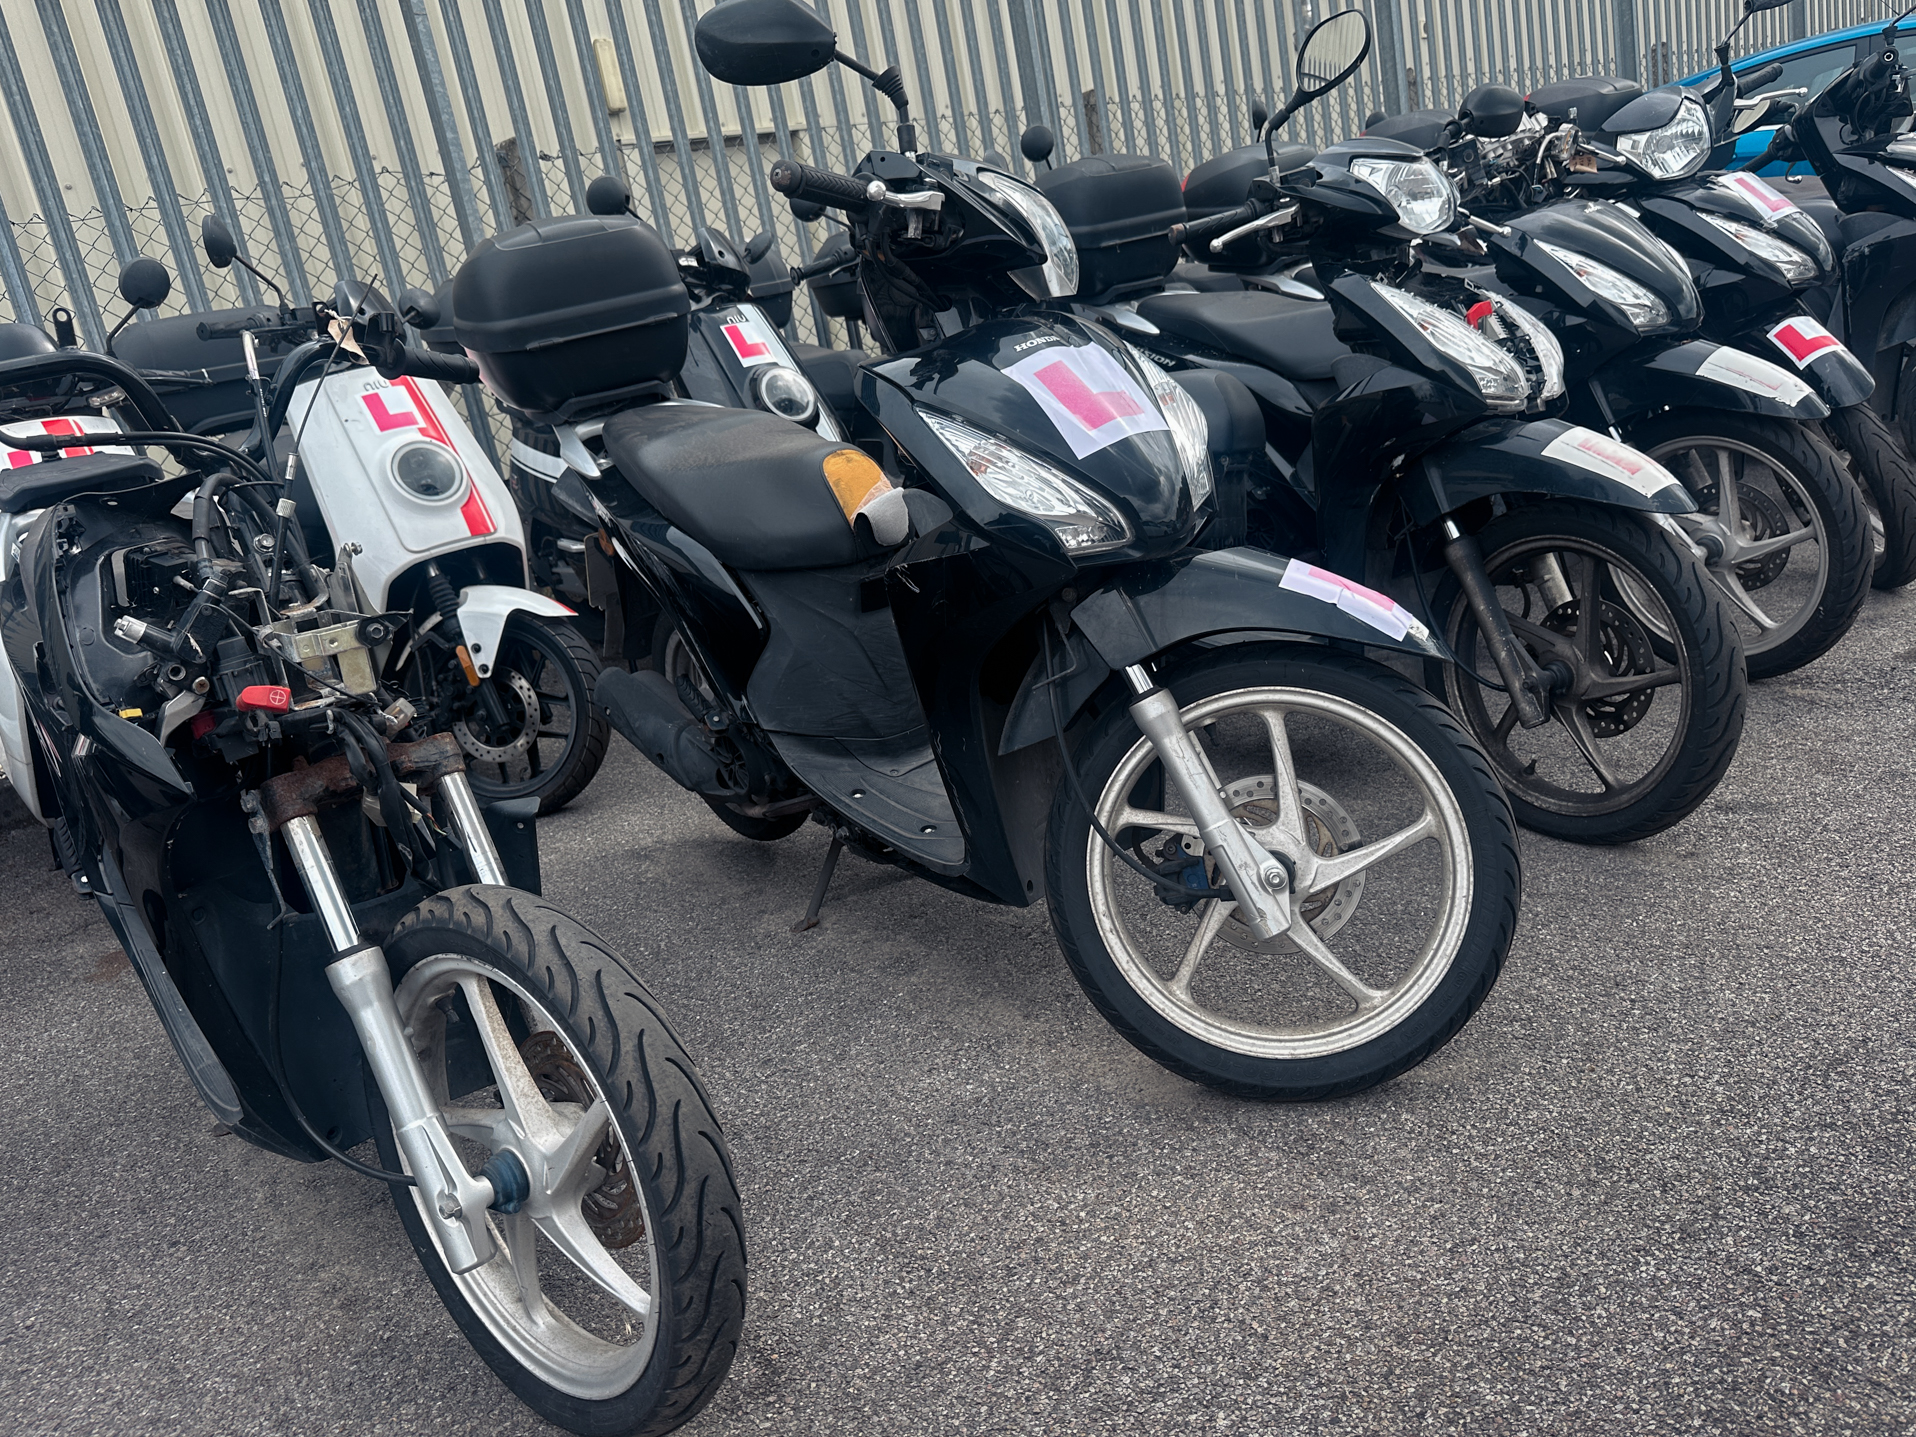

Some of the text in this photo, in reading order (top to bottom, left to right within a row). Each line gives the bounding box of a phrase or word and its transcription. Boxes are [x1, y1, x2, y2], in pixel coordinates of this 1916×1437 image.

[1734, 177, 1794, 213] L
[723, 324, 771, 359] L
[1013, 335, 1060, 352] HONDA
[1773, 323, 1840, 362] L
[361, 392, 419, 433] L
[1033, 360, 1145, 432] L
